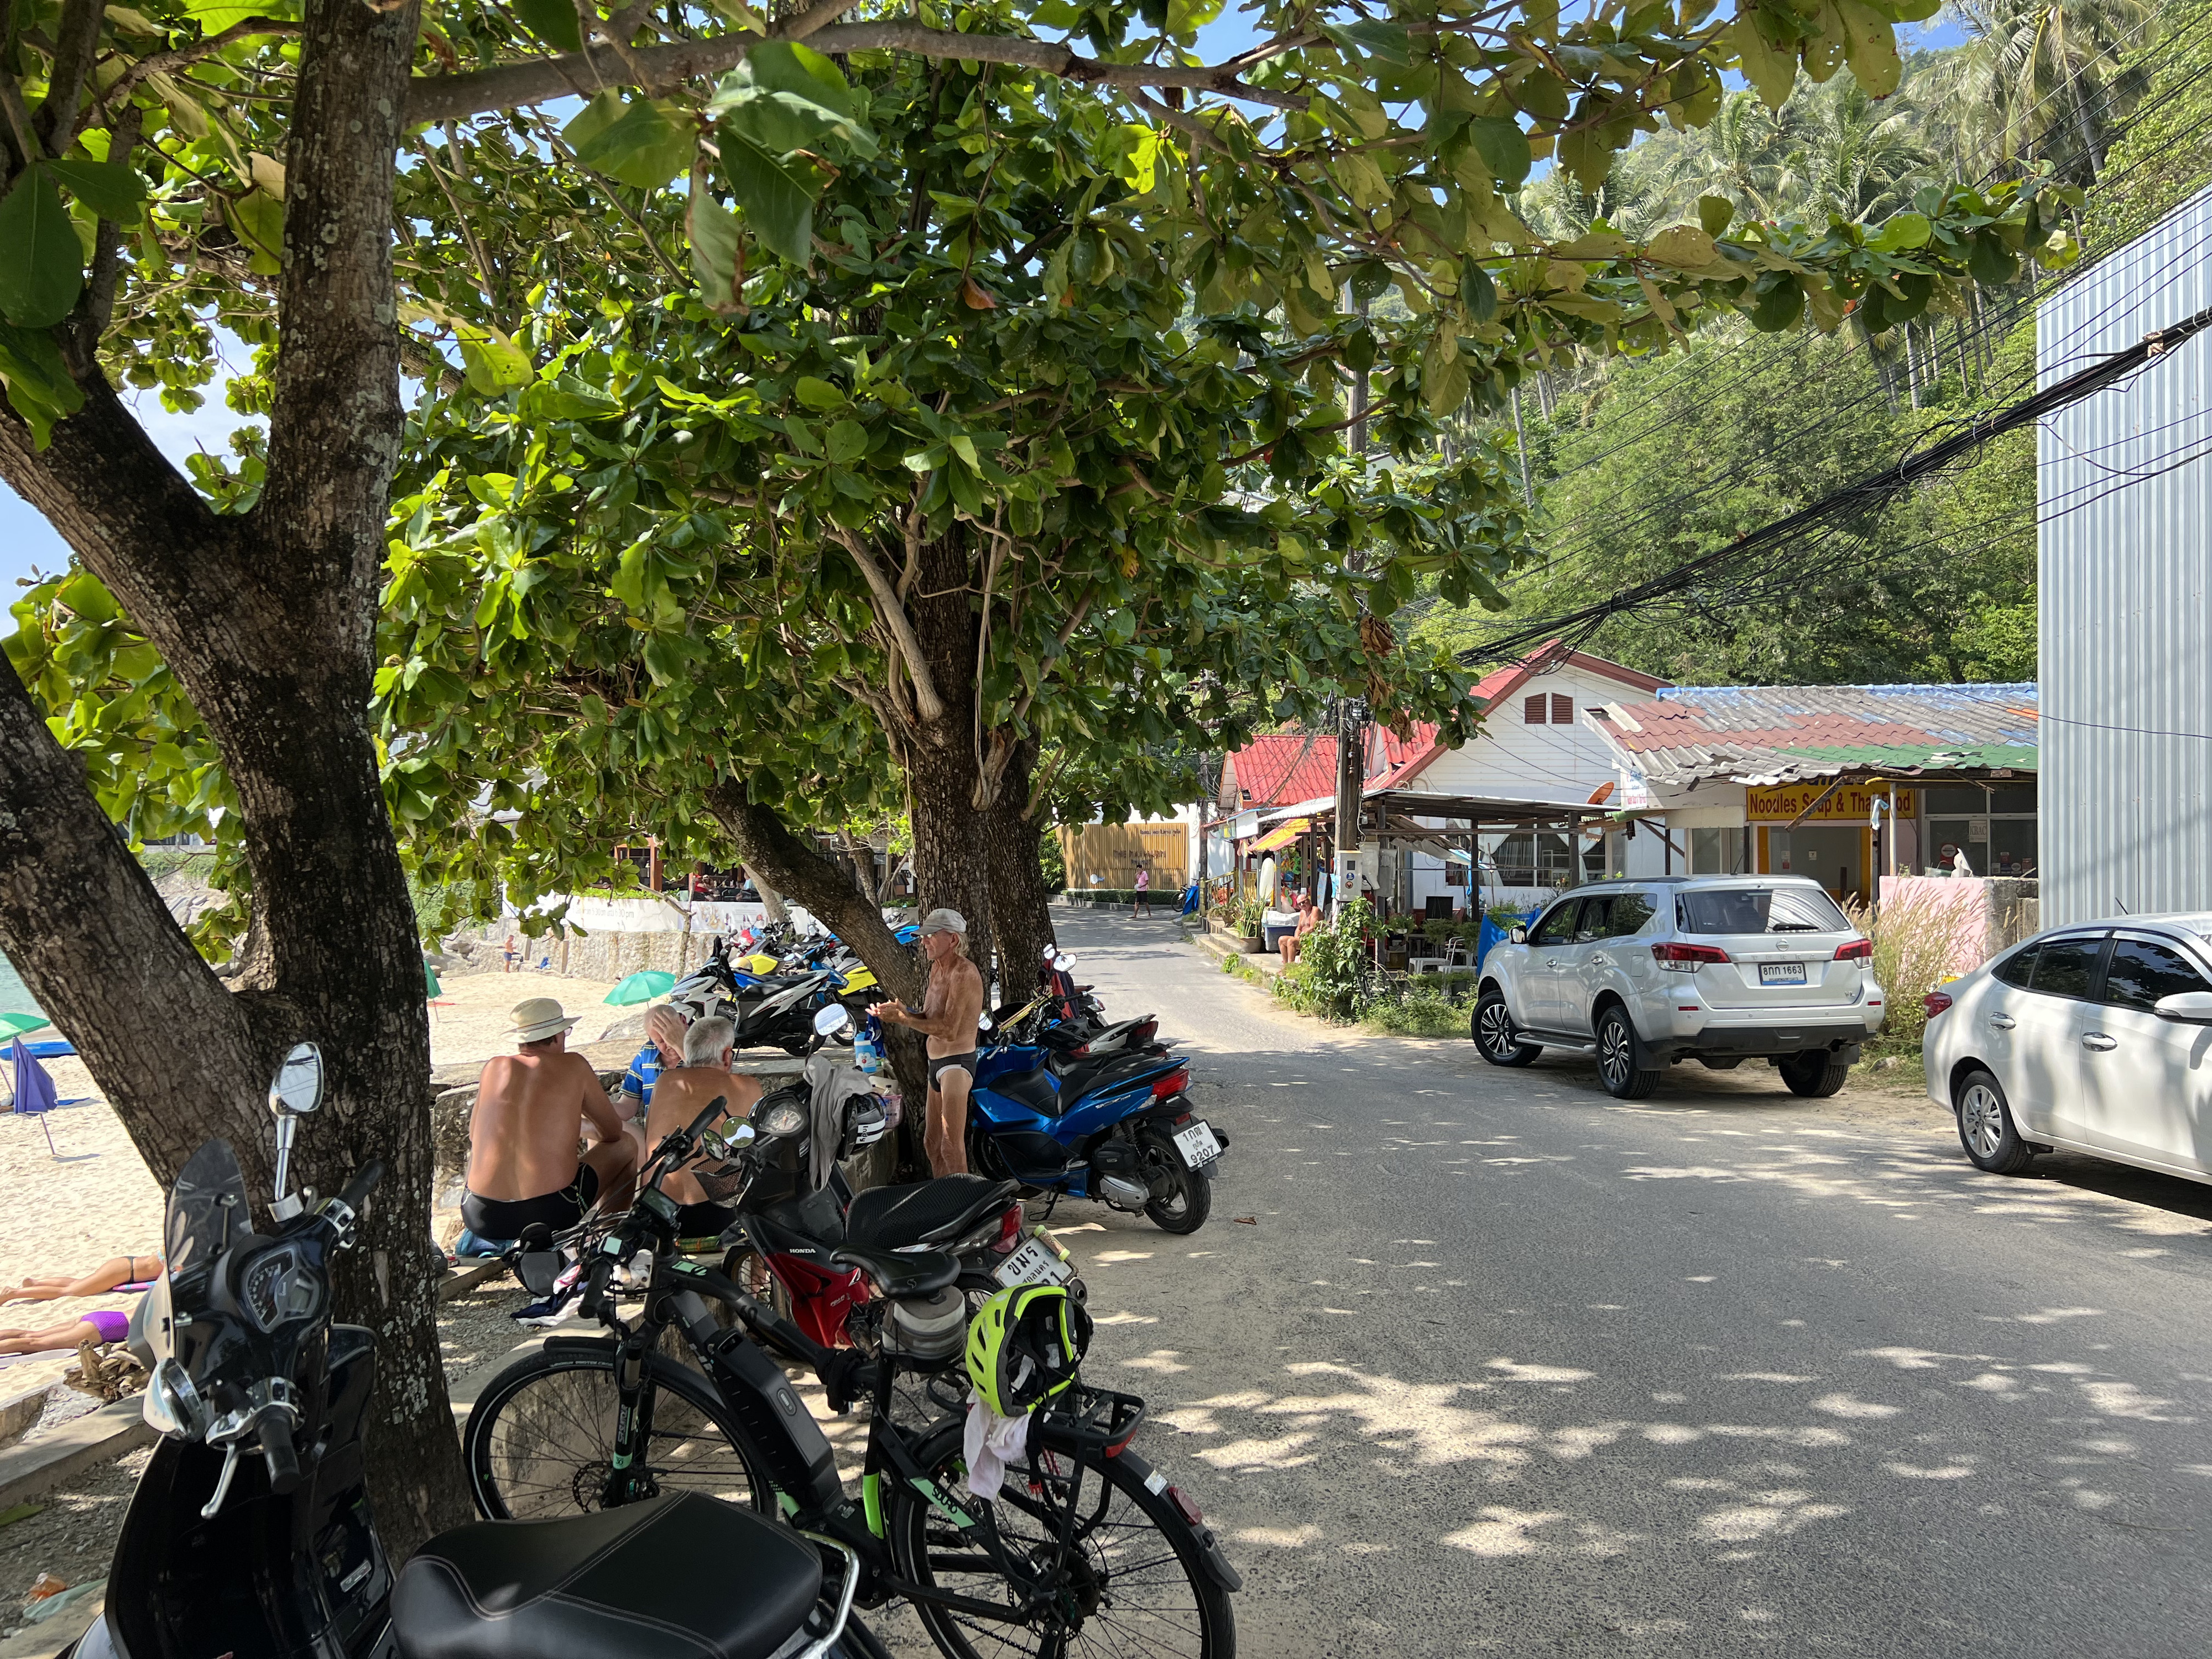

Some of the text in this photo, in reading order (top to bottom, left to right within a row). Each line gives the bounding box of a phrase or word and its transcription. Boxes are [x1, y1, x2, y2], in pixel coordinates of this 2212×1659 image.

[1750, 793, 1797, 813] Noodles
[1836, 791, 1845, 812] &
[1850, 791, 1876, 812] Tha
[625, 911, 634, 920] pm
[1783, 966, 1802, 974] 1663
[1190, 1144, 1215, 1164] 9207
